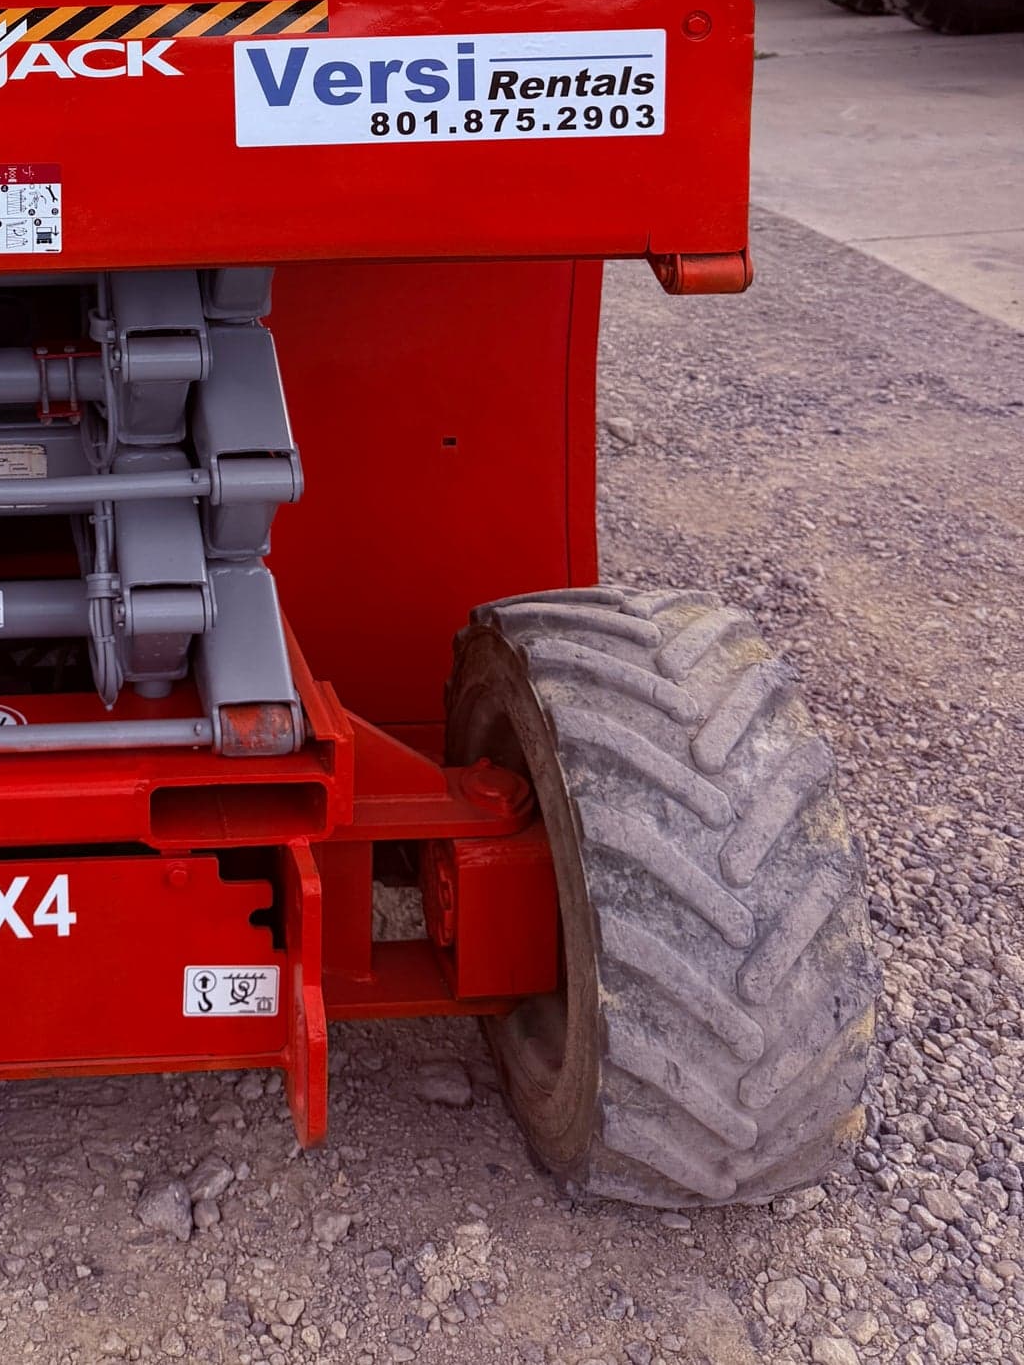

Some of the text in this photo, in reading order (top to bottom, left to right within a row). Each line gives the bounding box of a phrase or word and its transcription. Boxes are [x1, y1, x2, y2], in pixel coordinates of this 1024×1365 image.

[246, 42, 656, 107] Versi Rentals
[370, 104, 656, 136] 801.875.2903
